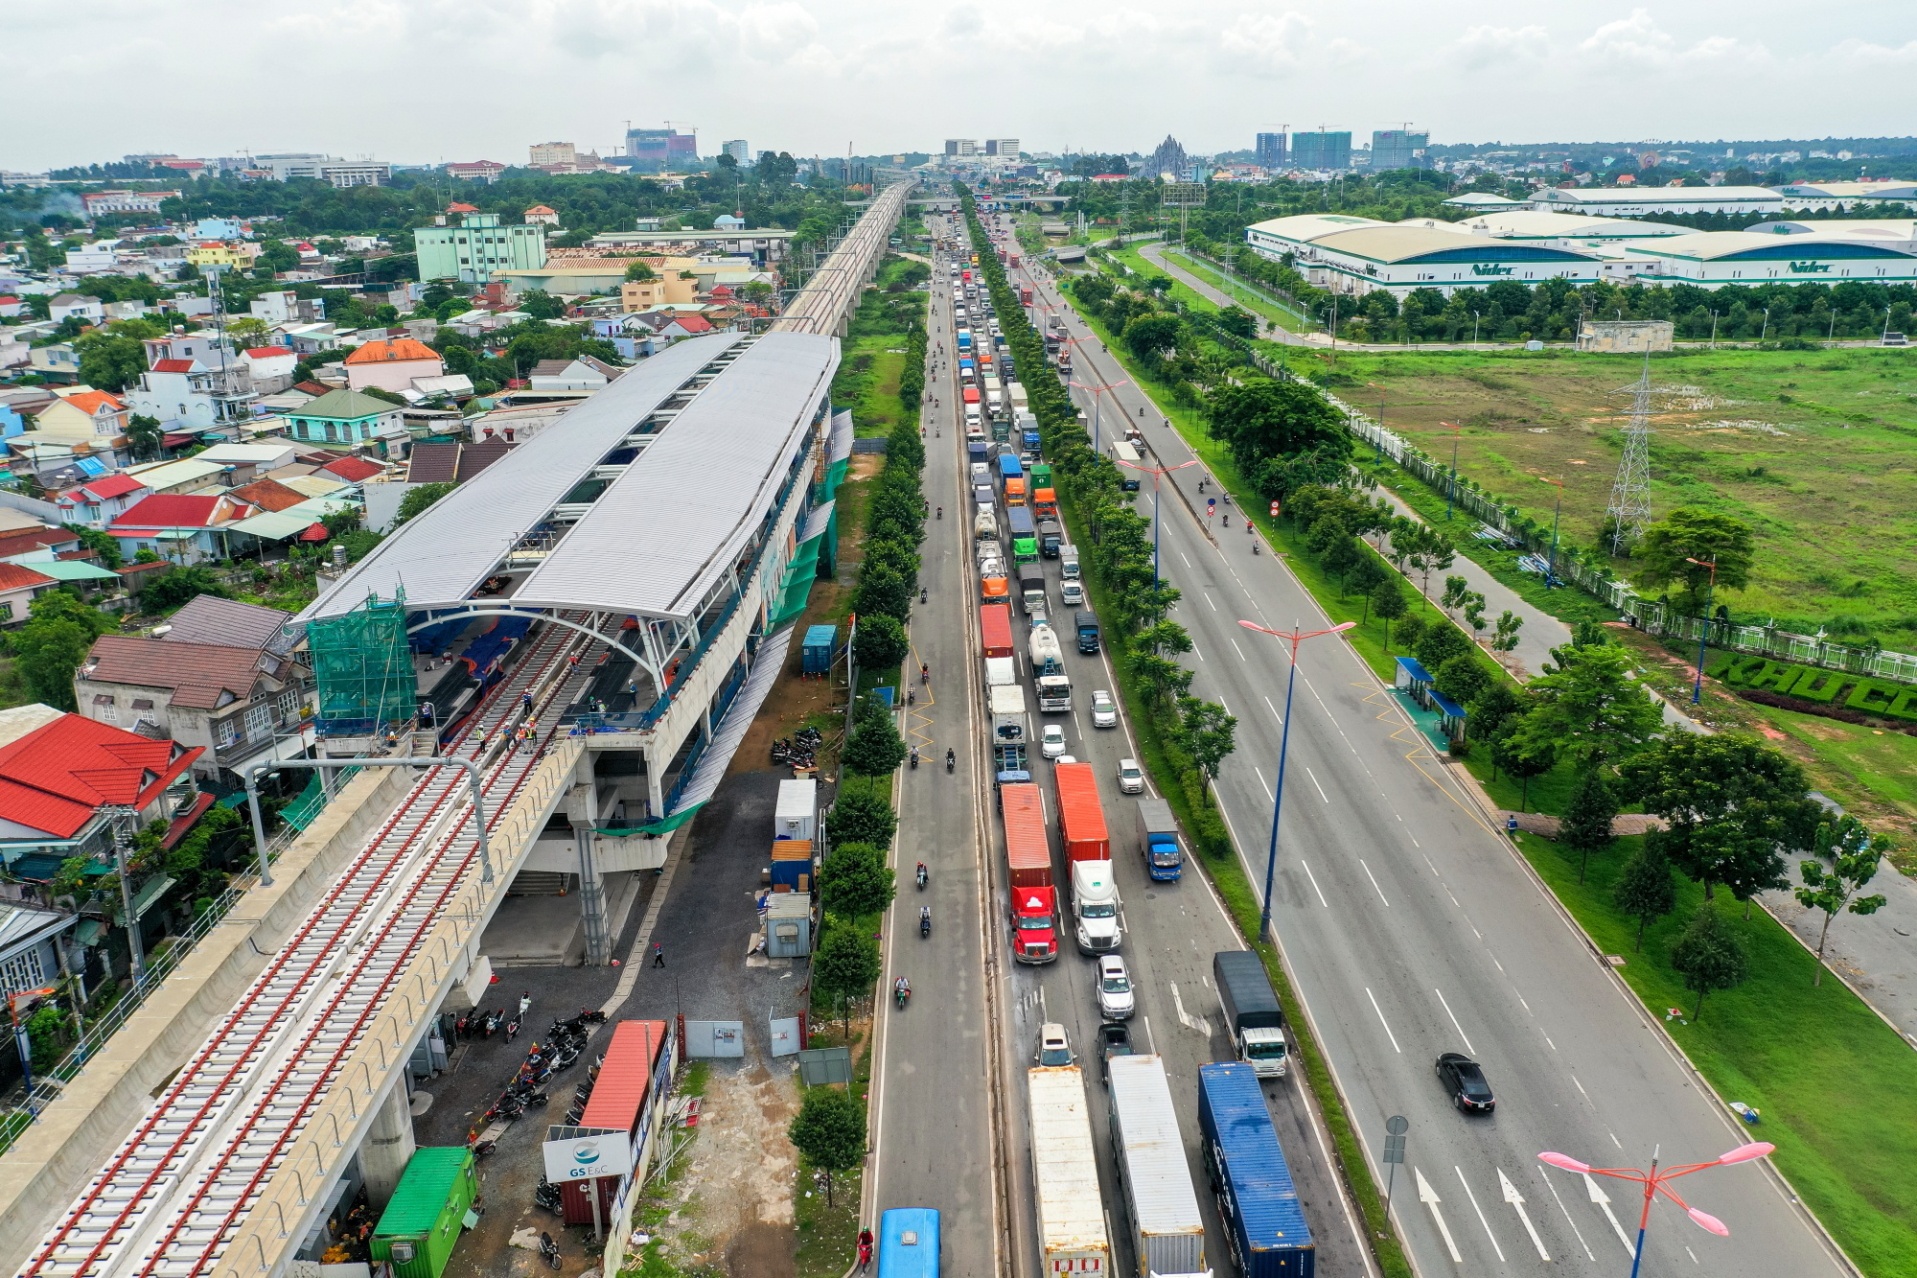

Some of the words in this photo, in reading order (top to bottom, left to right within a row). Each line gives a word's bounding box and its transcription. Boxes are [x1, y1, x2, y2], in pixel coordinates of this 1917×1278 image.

[1470, 263, 1518, 276] Nidec
[1786, 261, 1835, 273] Nidec
[1705, 652, 1848, 703] KHU
[570, 1167, 586, 1178] GS
[588, 1165, 609, 1176] E&C
